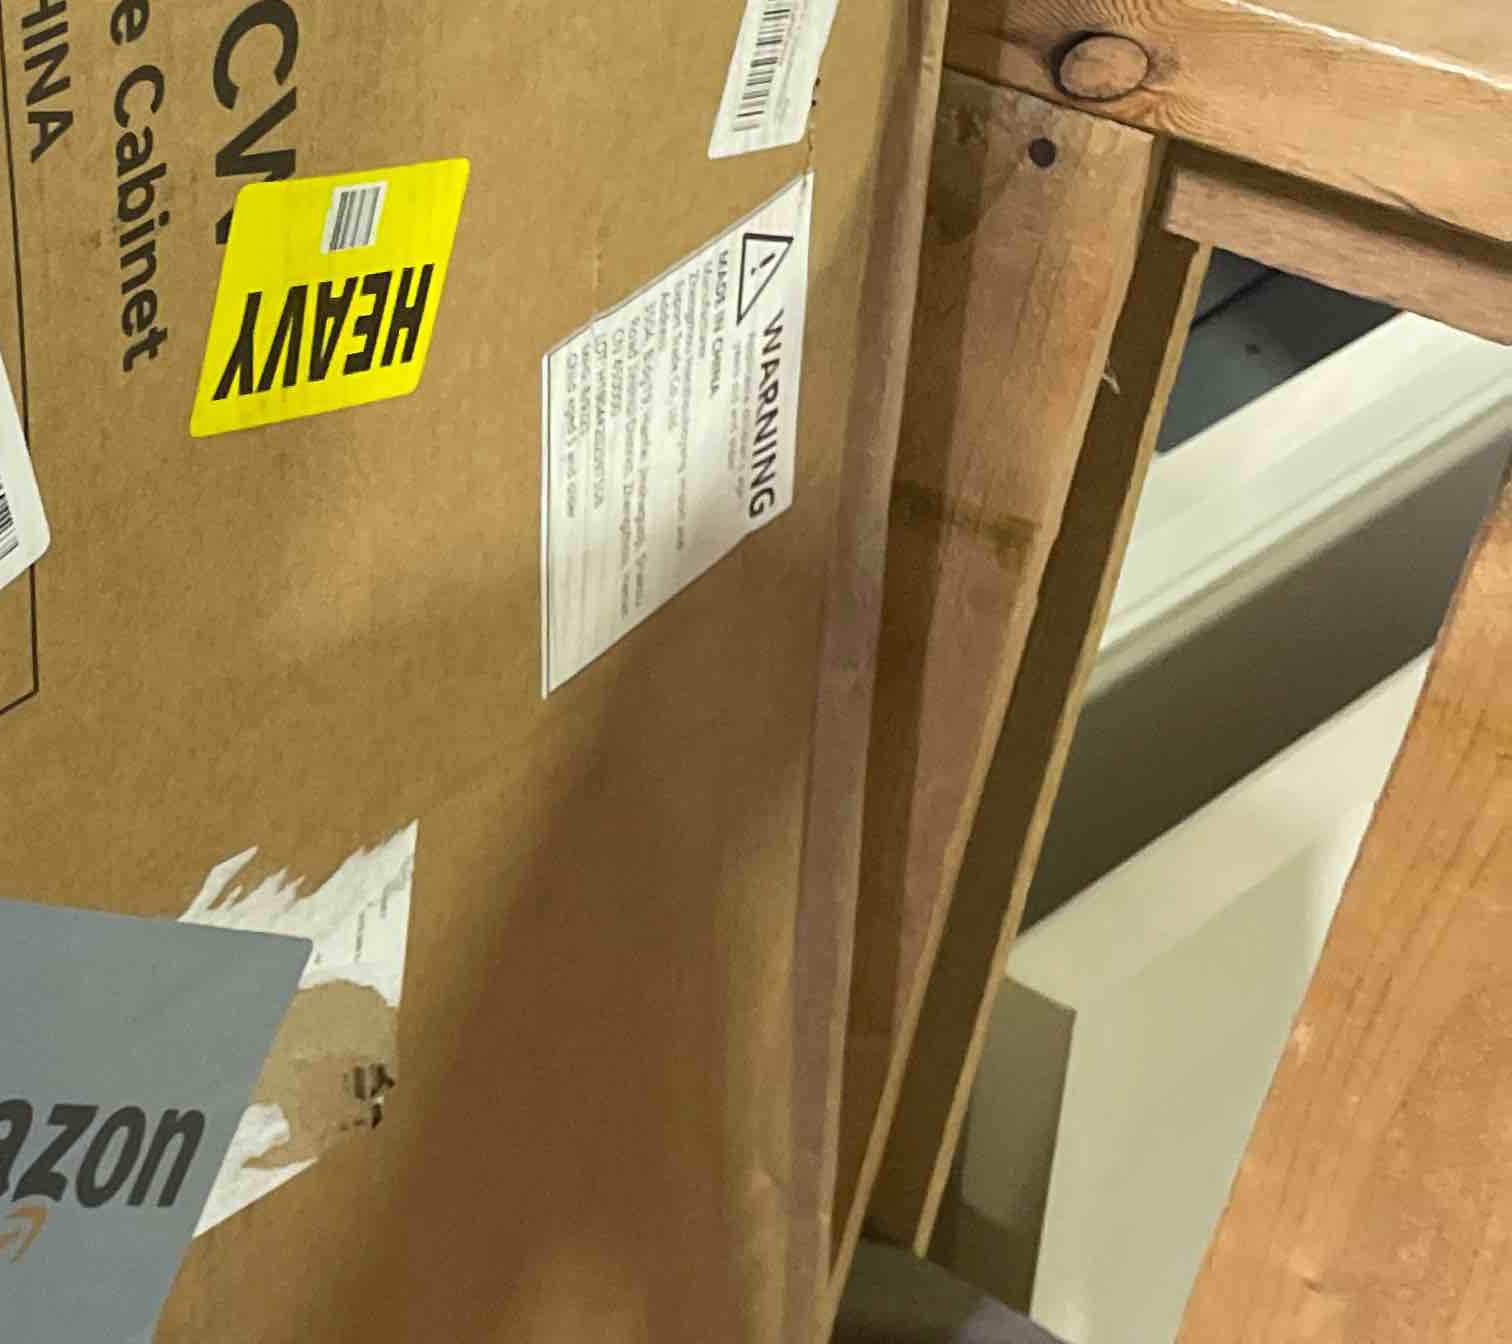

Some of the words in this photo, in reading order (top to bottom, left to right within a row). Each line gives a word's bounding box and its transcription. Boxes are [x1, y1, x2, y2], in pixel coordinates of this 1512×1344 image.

[113, 64, 169, 373] Cabinet
[212, 263, 436, 401] HEAVY
[749, 308, 786, 520] WARNING
